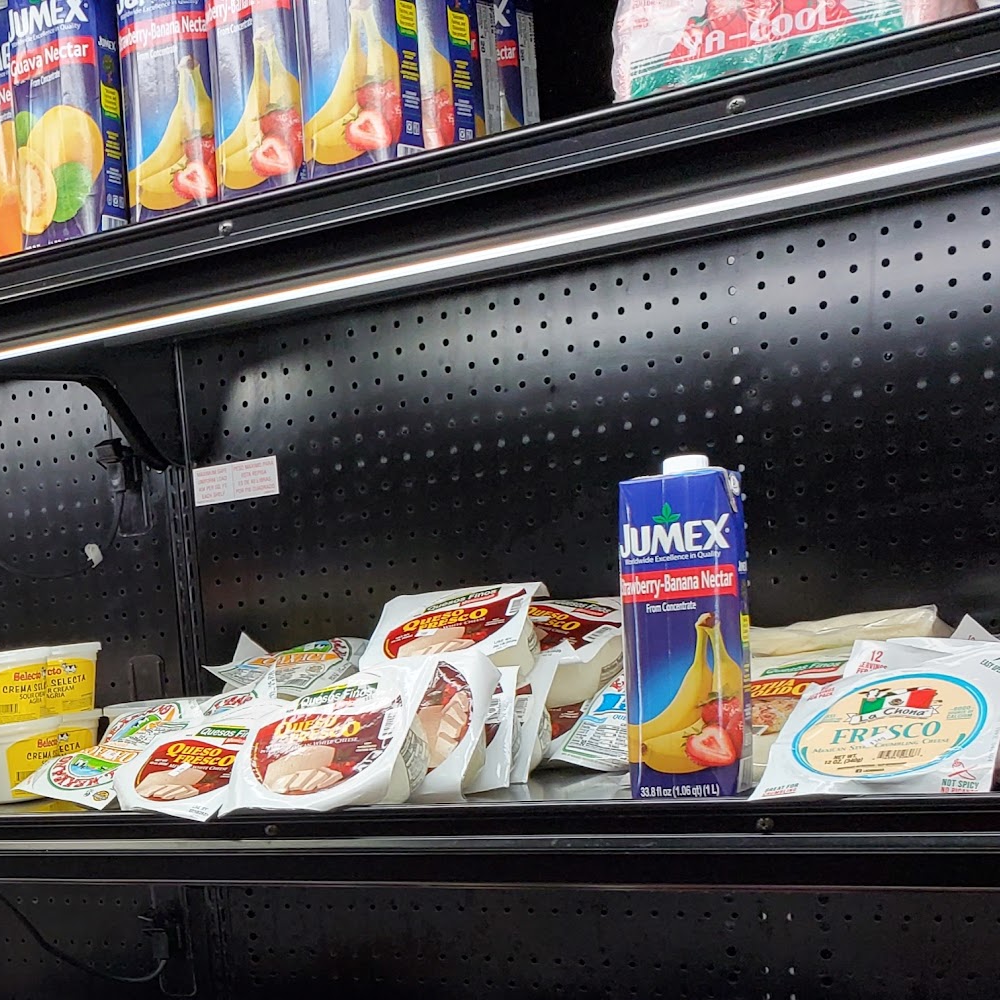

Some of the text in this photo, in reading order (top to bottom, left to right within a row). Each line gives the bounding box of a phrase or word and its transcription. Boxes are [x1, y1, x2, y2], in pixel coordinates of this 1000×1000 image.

[181, 15, 207, 33] Necta
[497, 45, 516, 61] ectar
[11, 43, 89, 78] Guava Nectar
[620, 513, 730, 558] JUMEX
[655, 553, 689, 563] Excellence
[697, 550, 721, 559] Quality
[701, 570, 734, 588] Nectar
[646, 601, 697, 614] From Concentrate
[402, 608, 465, 633] QUESO
[419, 607, 489, 631] FRESCO
[870, 650, 884, 662] 12
[51, 674, 87, 687] SELECTA
[751, 679, 796, 690] OTIJA
[2, 685, 32, 694] CREMA
[53, 685, 75, 693] CREAM
[859, 706, 926, 723] La Chona
[200, 728, 237, 738] Quesos
[830, 720, 942, 745] FRESCO
[922, 737, 950, 745] CHEESE
[27, 749, 51, 760] CREMA
[166, 742, 223, 757] QUESO
[173, 754, 236, 767] FRESCO
[941, 778, 980, 790] NOT SPICY
[640, 786, 656, 798] 33.8
[662, 787, 672, 797] oz
[673, 785, 692, 798] (1.06
